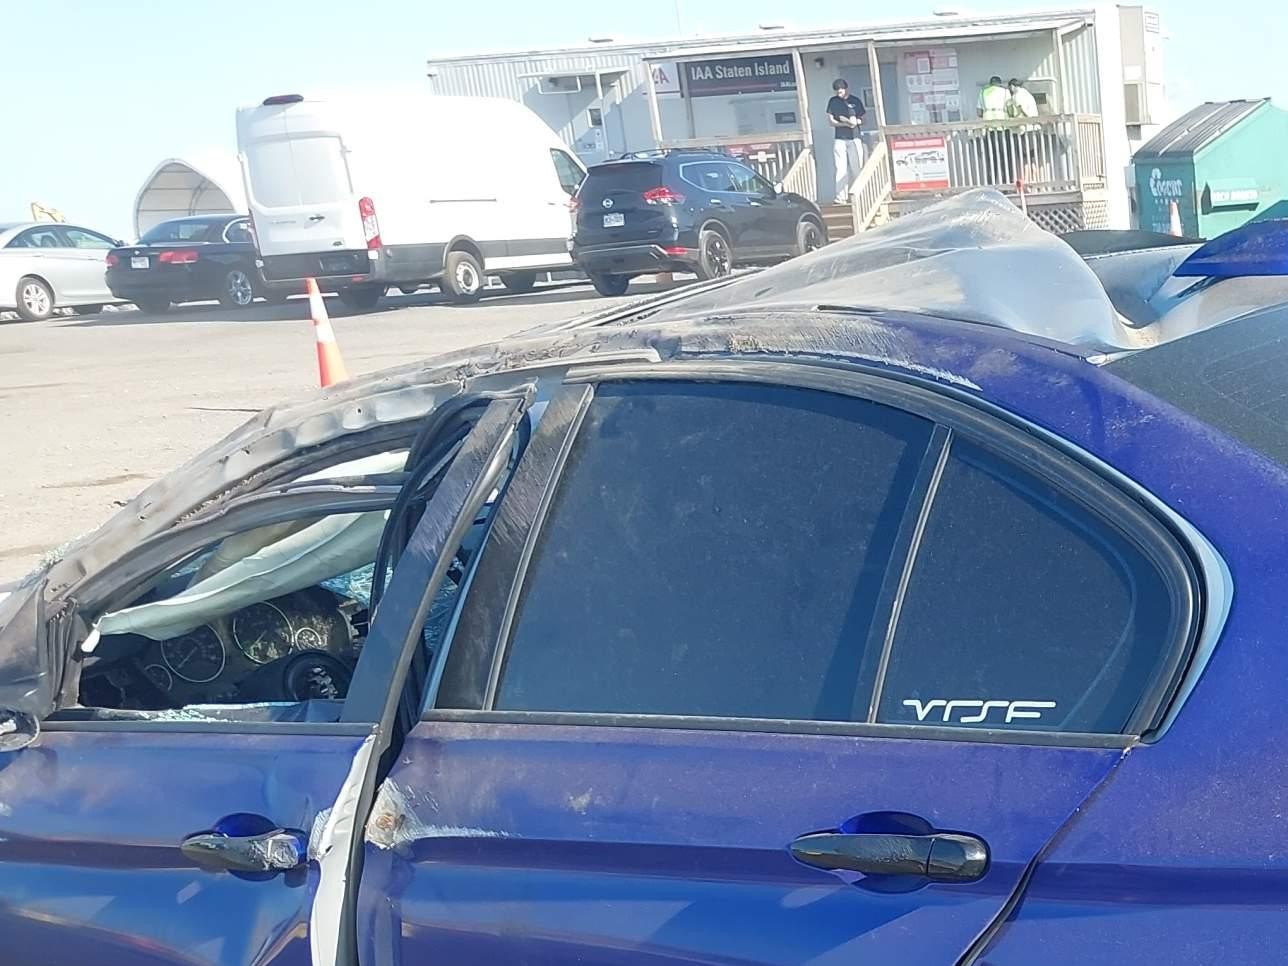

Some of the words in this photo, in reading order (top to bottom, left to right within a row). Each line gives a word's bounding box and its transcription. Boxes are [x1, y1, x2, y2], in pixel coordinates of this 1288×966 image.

[691, 65, 714, 81] IAA
[715, 63, 752, 79] Staten
[754, 60, 790, 76] Island
